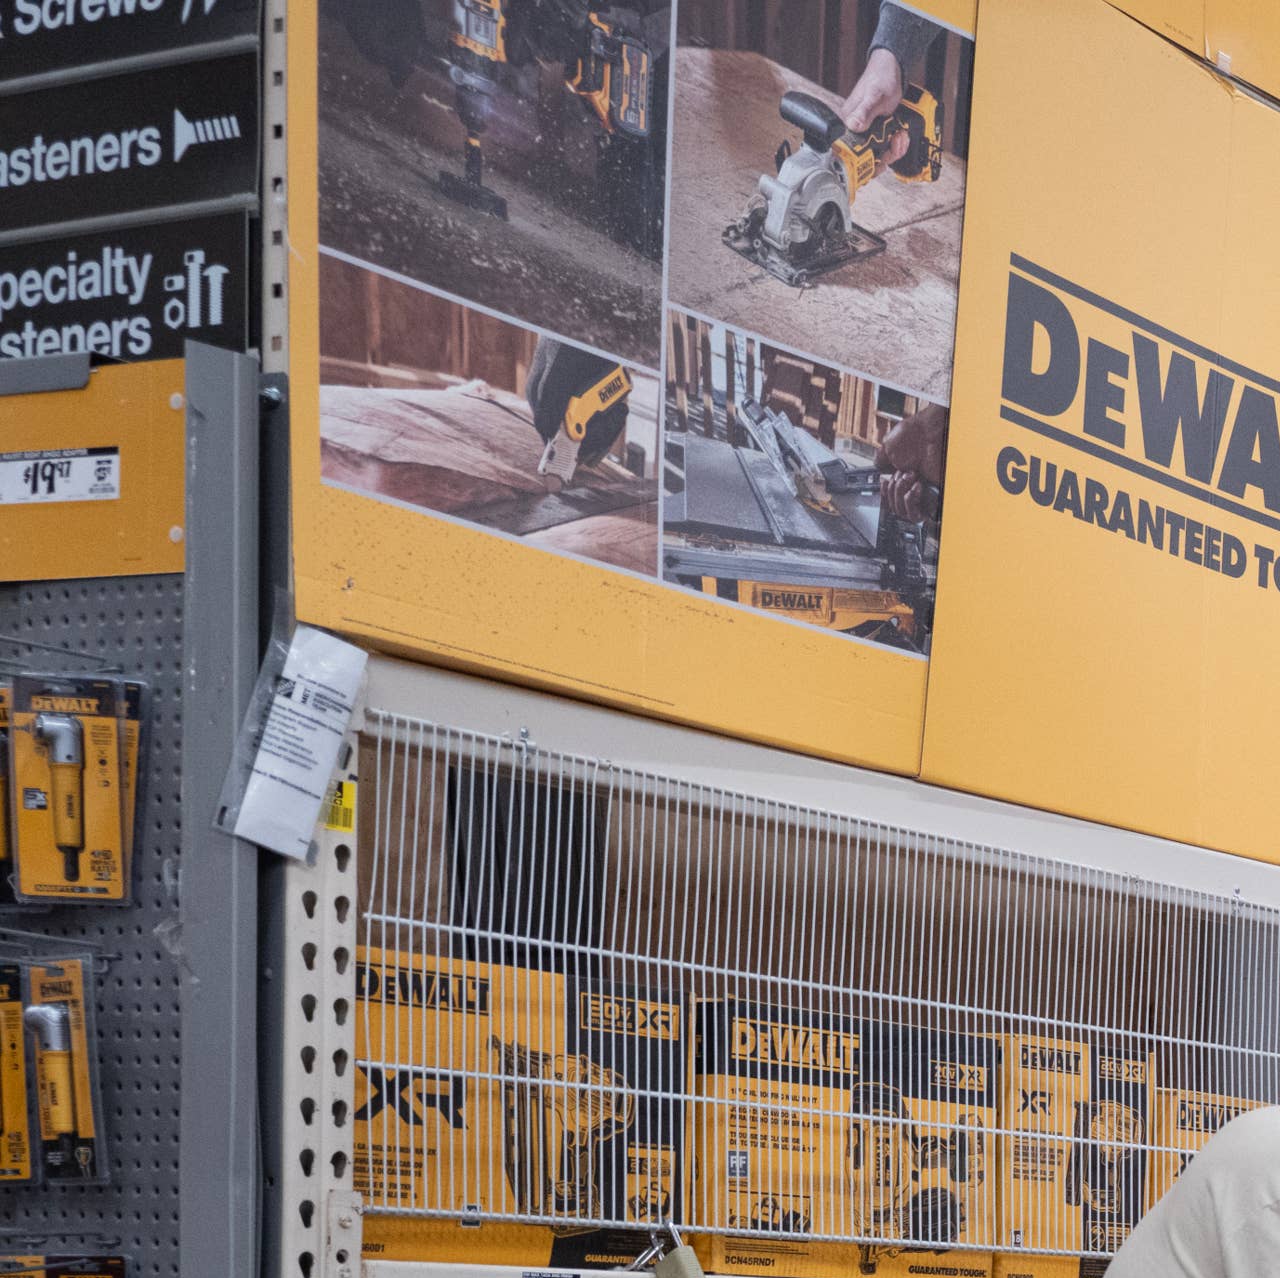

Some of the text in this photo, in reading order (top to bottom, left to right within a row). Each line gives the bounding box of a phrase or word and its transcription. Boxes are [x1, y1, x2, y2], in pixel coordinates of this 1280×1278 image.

[0, 127, 162, 188] steners
[0, 246, 153, 322] pecialty
[0, 316, 152, 358] steners
[996, 446, 1247, 579] GUARANTEED
[761, 591, 823, 610] DEWALT
[356, 964, 489, 1012] DEWALT
[732, 1020, 859, 1072] DEWALT
[1021, 1048, 1081, 1071] DEWALT
[908, 1265, 958, 1277] GUARANTEED
